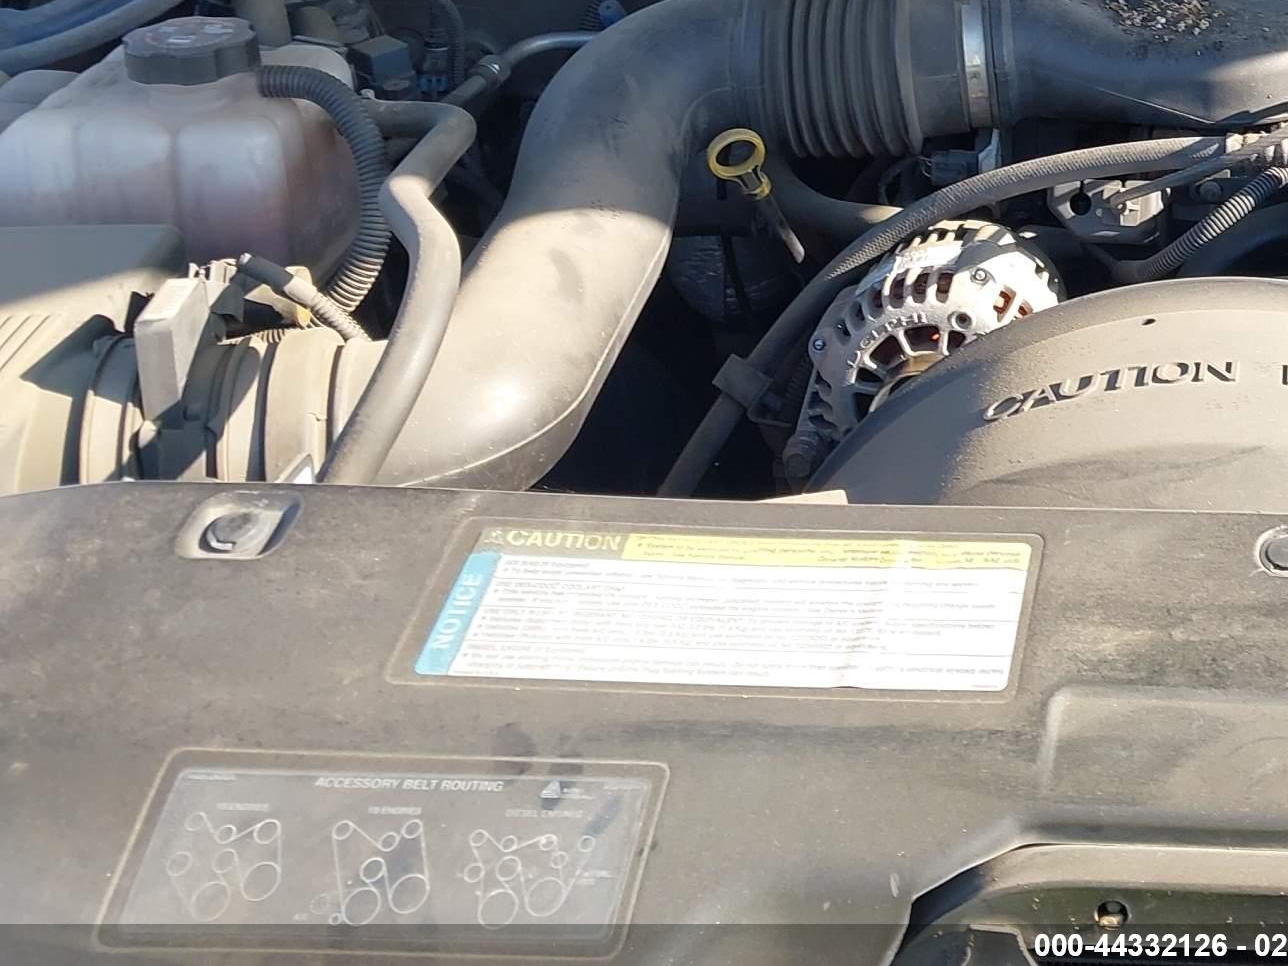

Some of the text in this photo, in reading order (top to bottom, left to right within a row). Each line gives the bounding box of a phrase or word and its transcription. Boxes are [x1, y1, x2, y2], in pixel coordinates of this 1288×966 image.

[983, 360, 1241, 422] CAUTION
[505, 530, 622, 551] CAUTION
[432, 573, 482, 651] NOTICE
[313, 777, 504, 793] ACCESSORY BELT ROUTING
